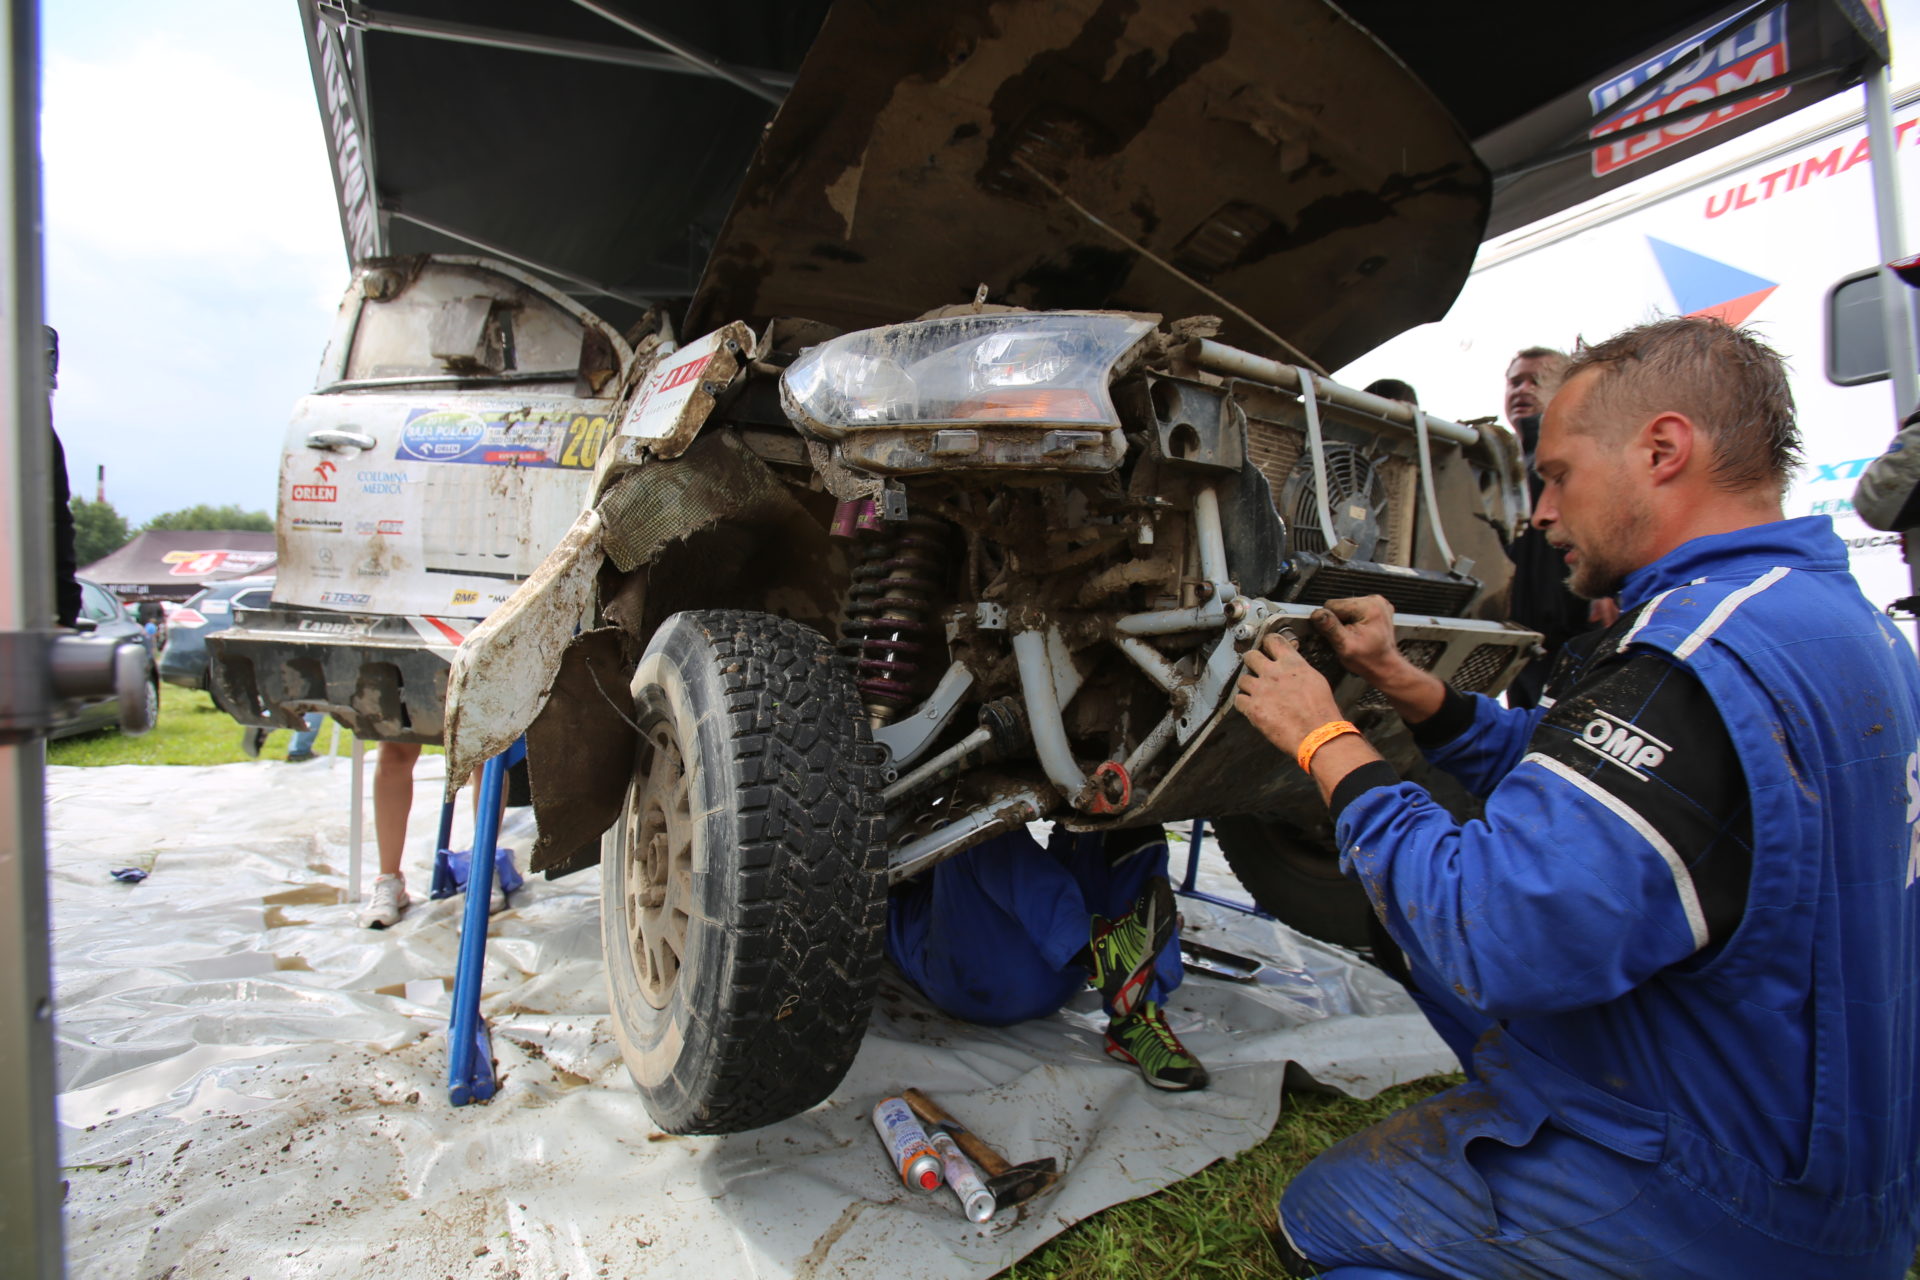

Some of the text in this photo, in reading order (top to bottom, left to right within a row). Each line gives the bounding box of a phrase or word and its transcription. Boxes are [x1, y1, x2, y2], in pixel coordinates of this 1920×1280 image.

[435, 424, 482, 437] POLAND
[357, 471, 408, 483] COLUMNA
[293, 486, 335, 501] ORLEN
[362, 483, 402, 494] MEDICA
[1582, 718, 1665, 769] OMP
